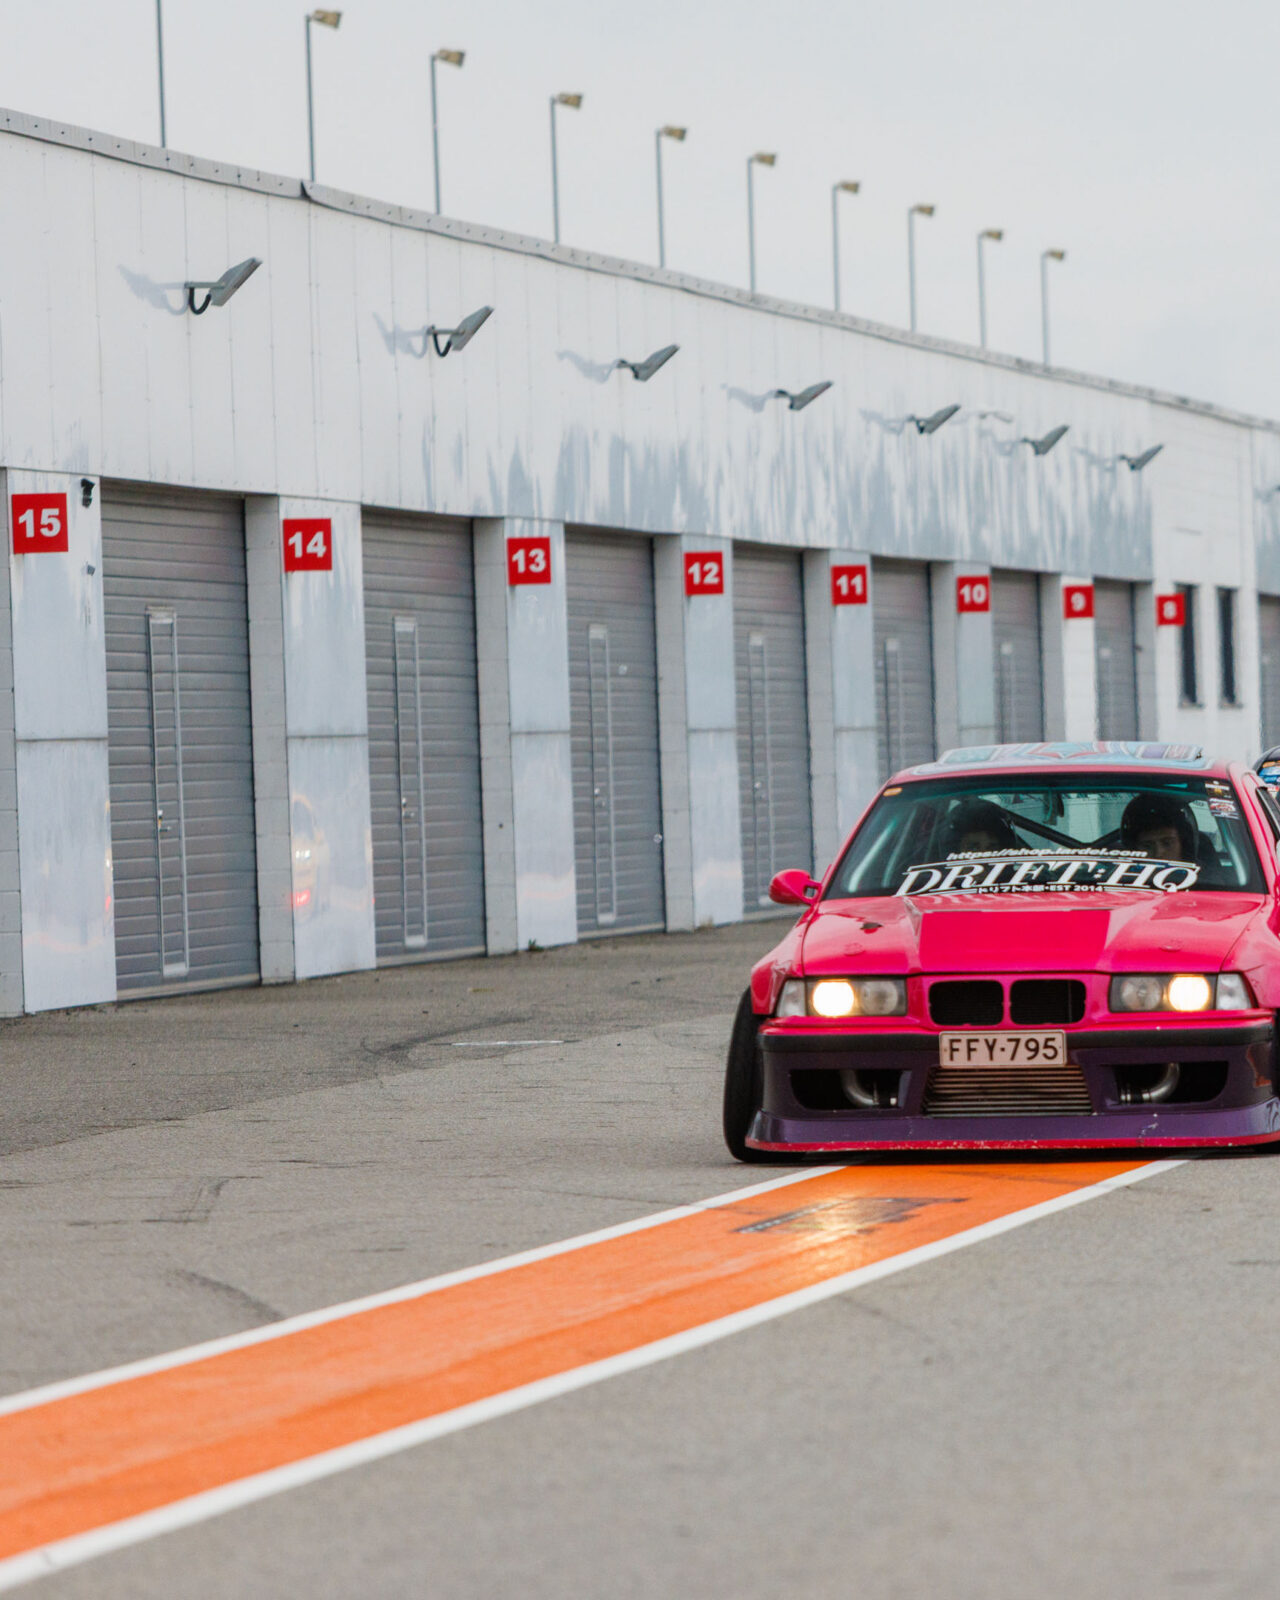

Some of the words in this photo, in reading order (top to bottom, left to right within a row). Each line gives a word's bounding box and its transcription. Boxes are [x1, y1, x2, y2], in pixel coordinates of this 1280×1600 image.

[18, 507, 61, 538] 15
[287, 531, 327, 558] 14
[510, 548, 547, 573] 13
[687, 561, 720, 585] 12
[836, 574, 864, 596] 11
[960, 584, 988, 604] 10
[1071, 592, 1086, 612] 9
[1163, 600, 1178, 620] 8
[894, 861, 1200, 897] DRIFT:HQ
[1073, 884, 1103, 893] 2014
[948, 1037, 1059, 1061] FFY-795
